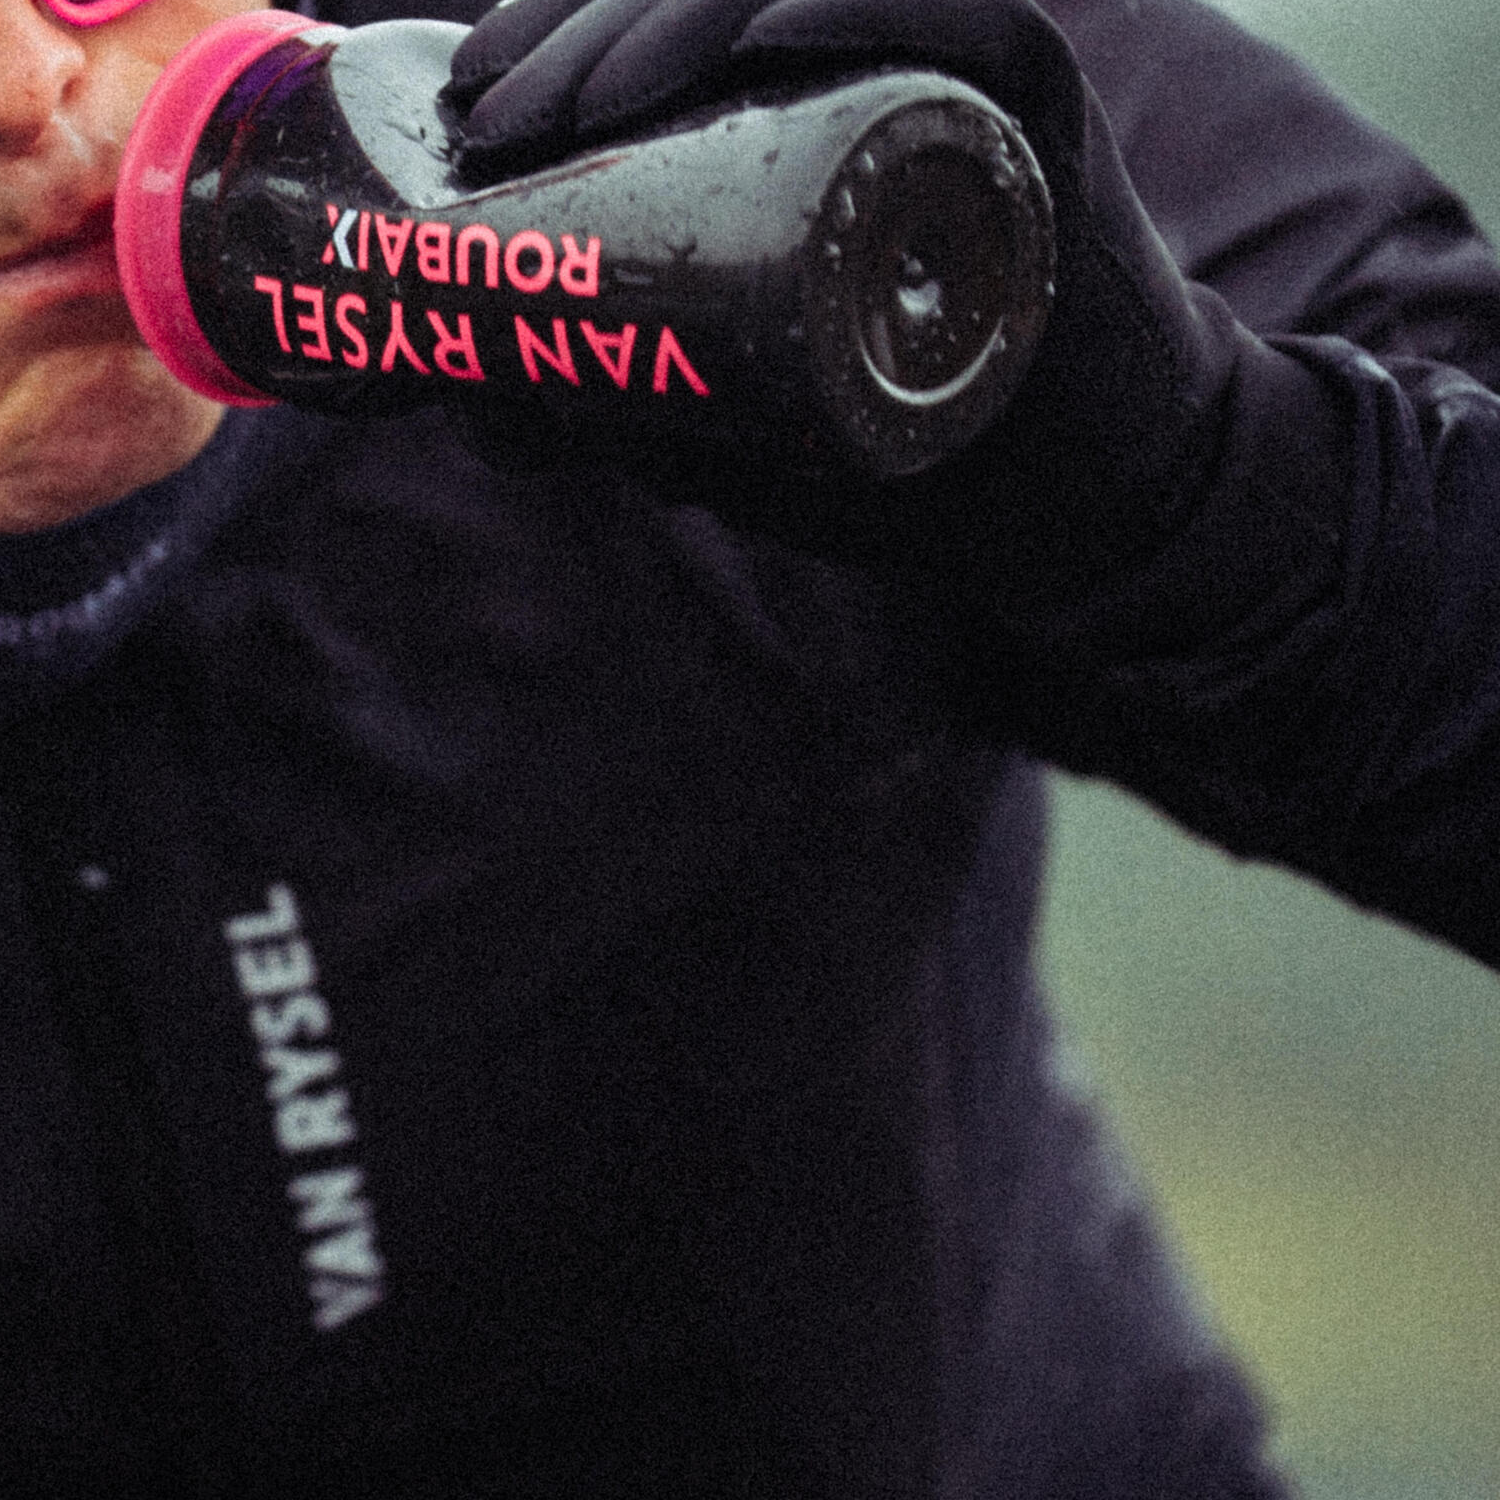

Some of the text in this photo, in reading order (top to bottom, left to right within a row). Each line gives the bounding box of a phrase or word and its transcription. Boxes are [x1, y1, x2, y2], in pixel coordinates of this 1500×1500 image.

[321, 203, 602, 298] ROUBAIX
[254, 275, 711, 397] VAN RYSEL
[222, 881, 386, 1331] VAN RYSEL
